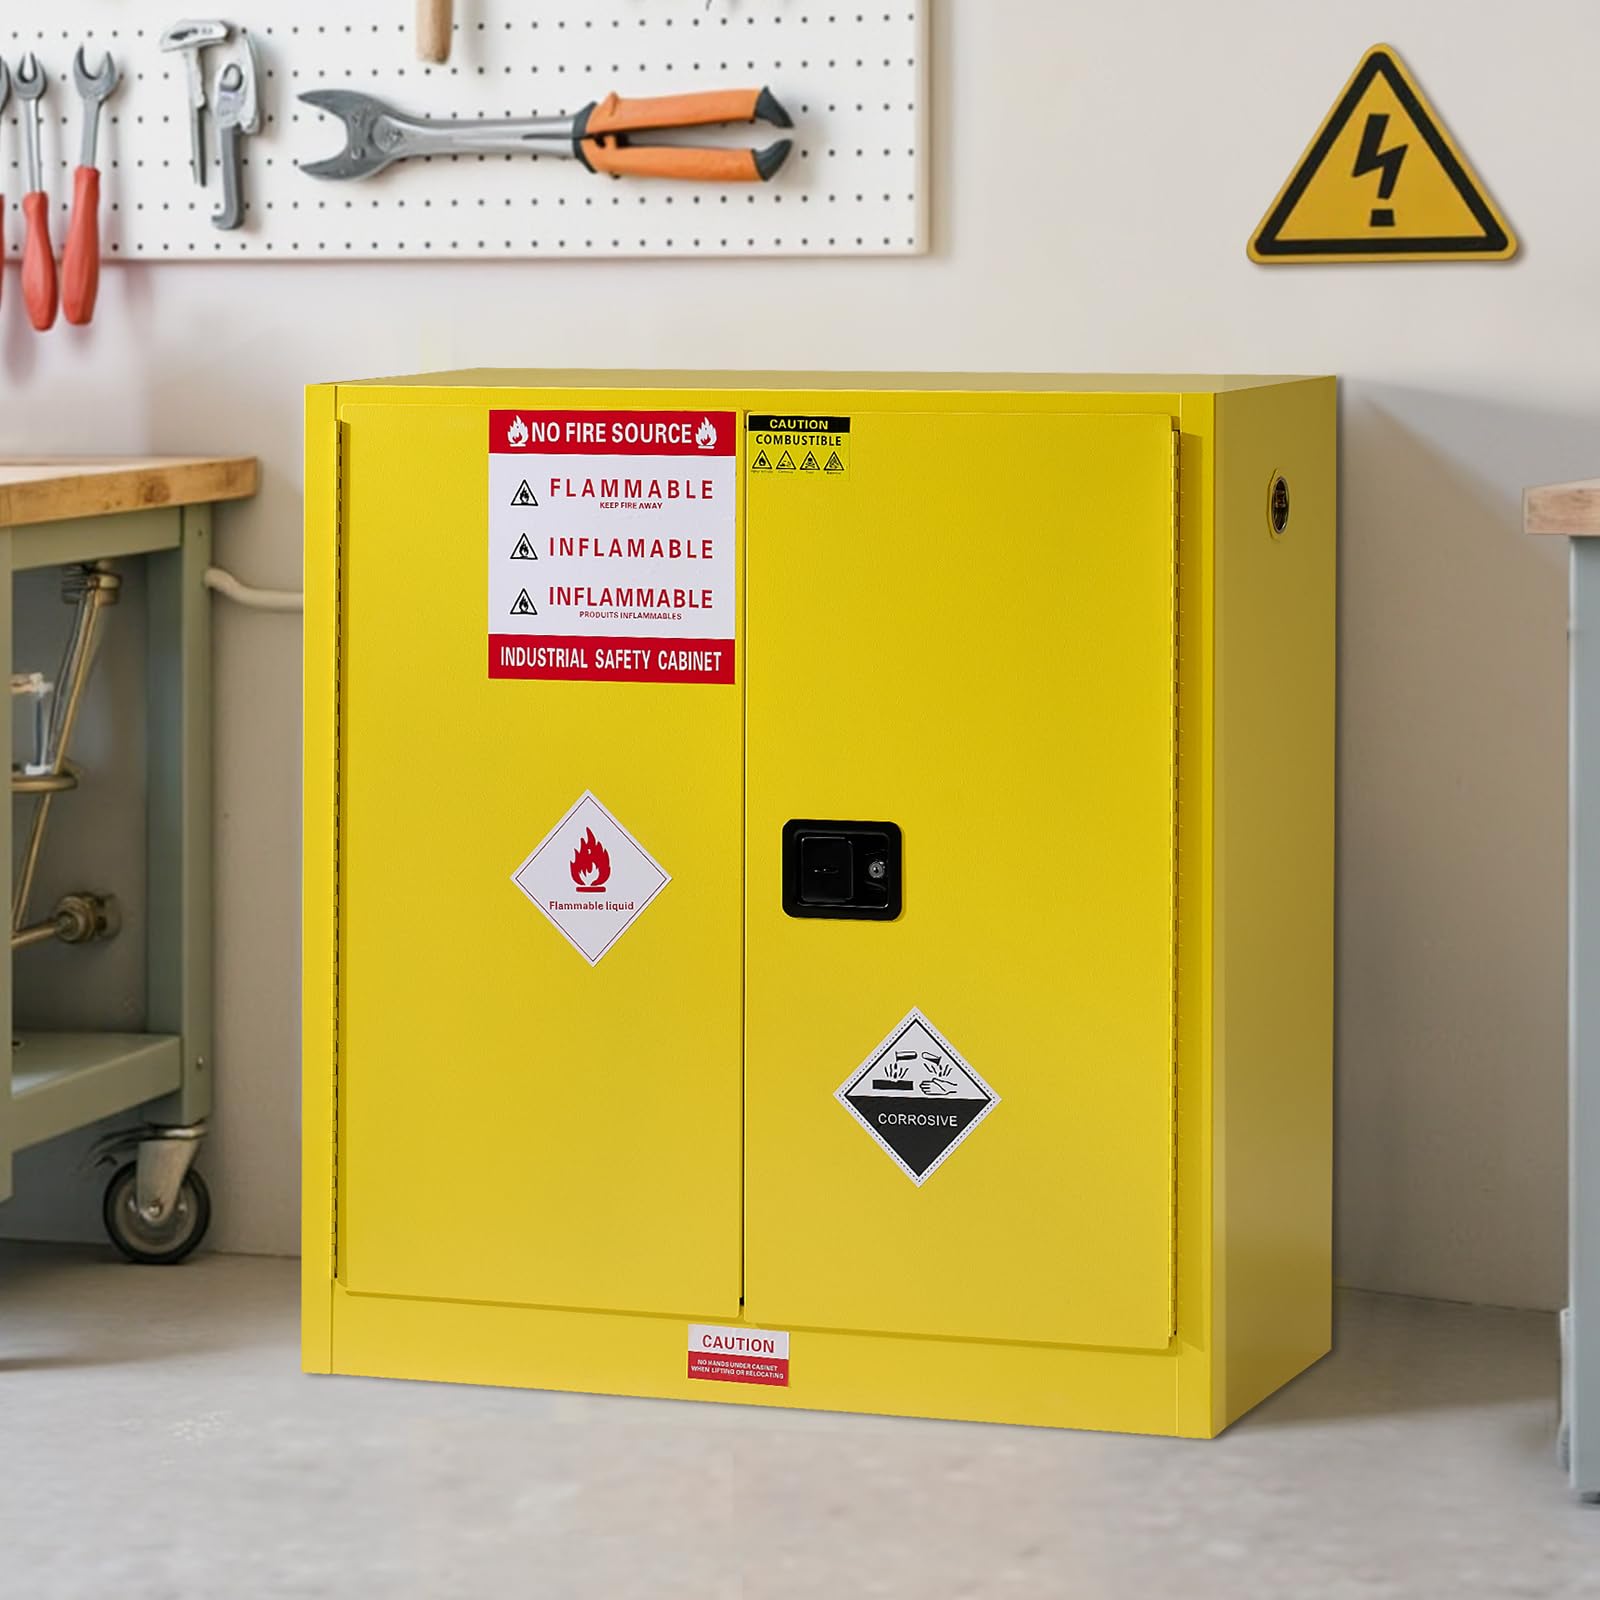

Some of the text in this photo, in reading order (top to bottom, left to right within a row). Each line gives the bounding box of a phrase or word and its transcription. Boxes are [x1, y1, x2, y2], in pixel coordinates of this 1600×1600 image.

[770, 419, 828, 430] CAUTION
[532, 422, 693, 444] NO FIRE SOURCE
[756, 434, 841, 446] COMBUSTIBLE
[550, 478, 713, 499] FLAMMABLE
[549, 537, 713, 559] INFLAMABLE
[549, 587, 713, 608] INFLAMMABLE
[580, 611, 682, 620] PRODUITS INFLAMMABLES
[500, 646, 722, 671] INDUSTRIAL SAFETY CABINET
[549, 901, 634, 911] Flammable liquid
[878, 1113, 958, 1126] CORROSIVE
[702, 1334, 774, 1353] CAUTION
[746, 1371, 783, 1379] RELOCATING
